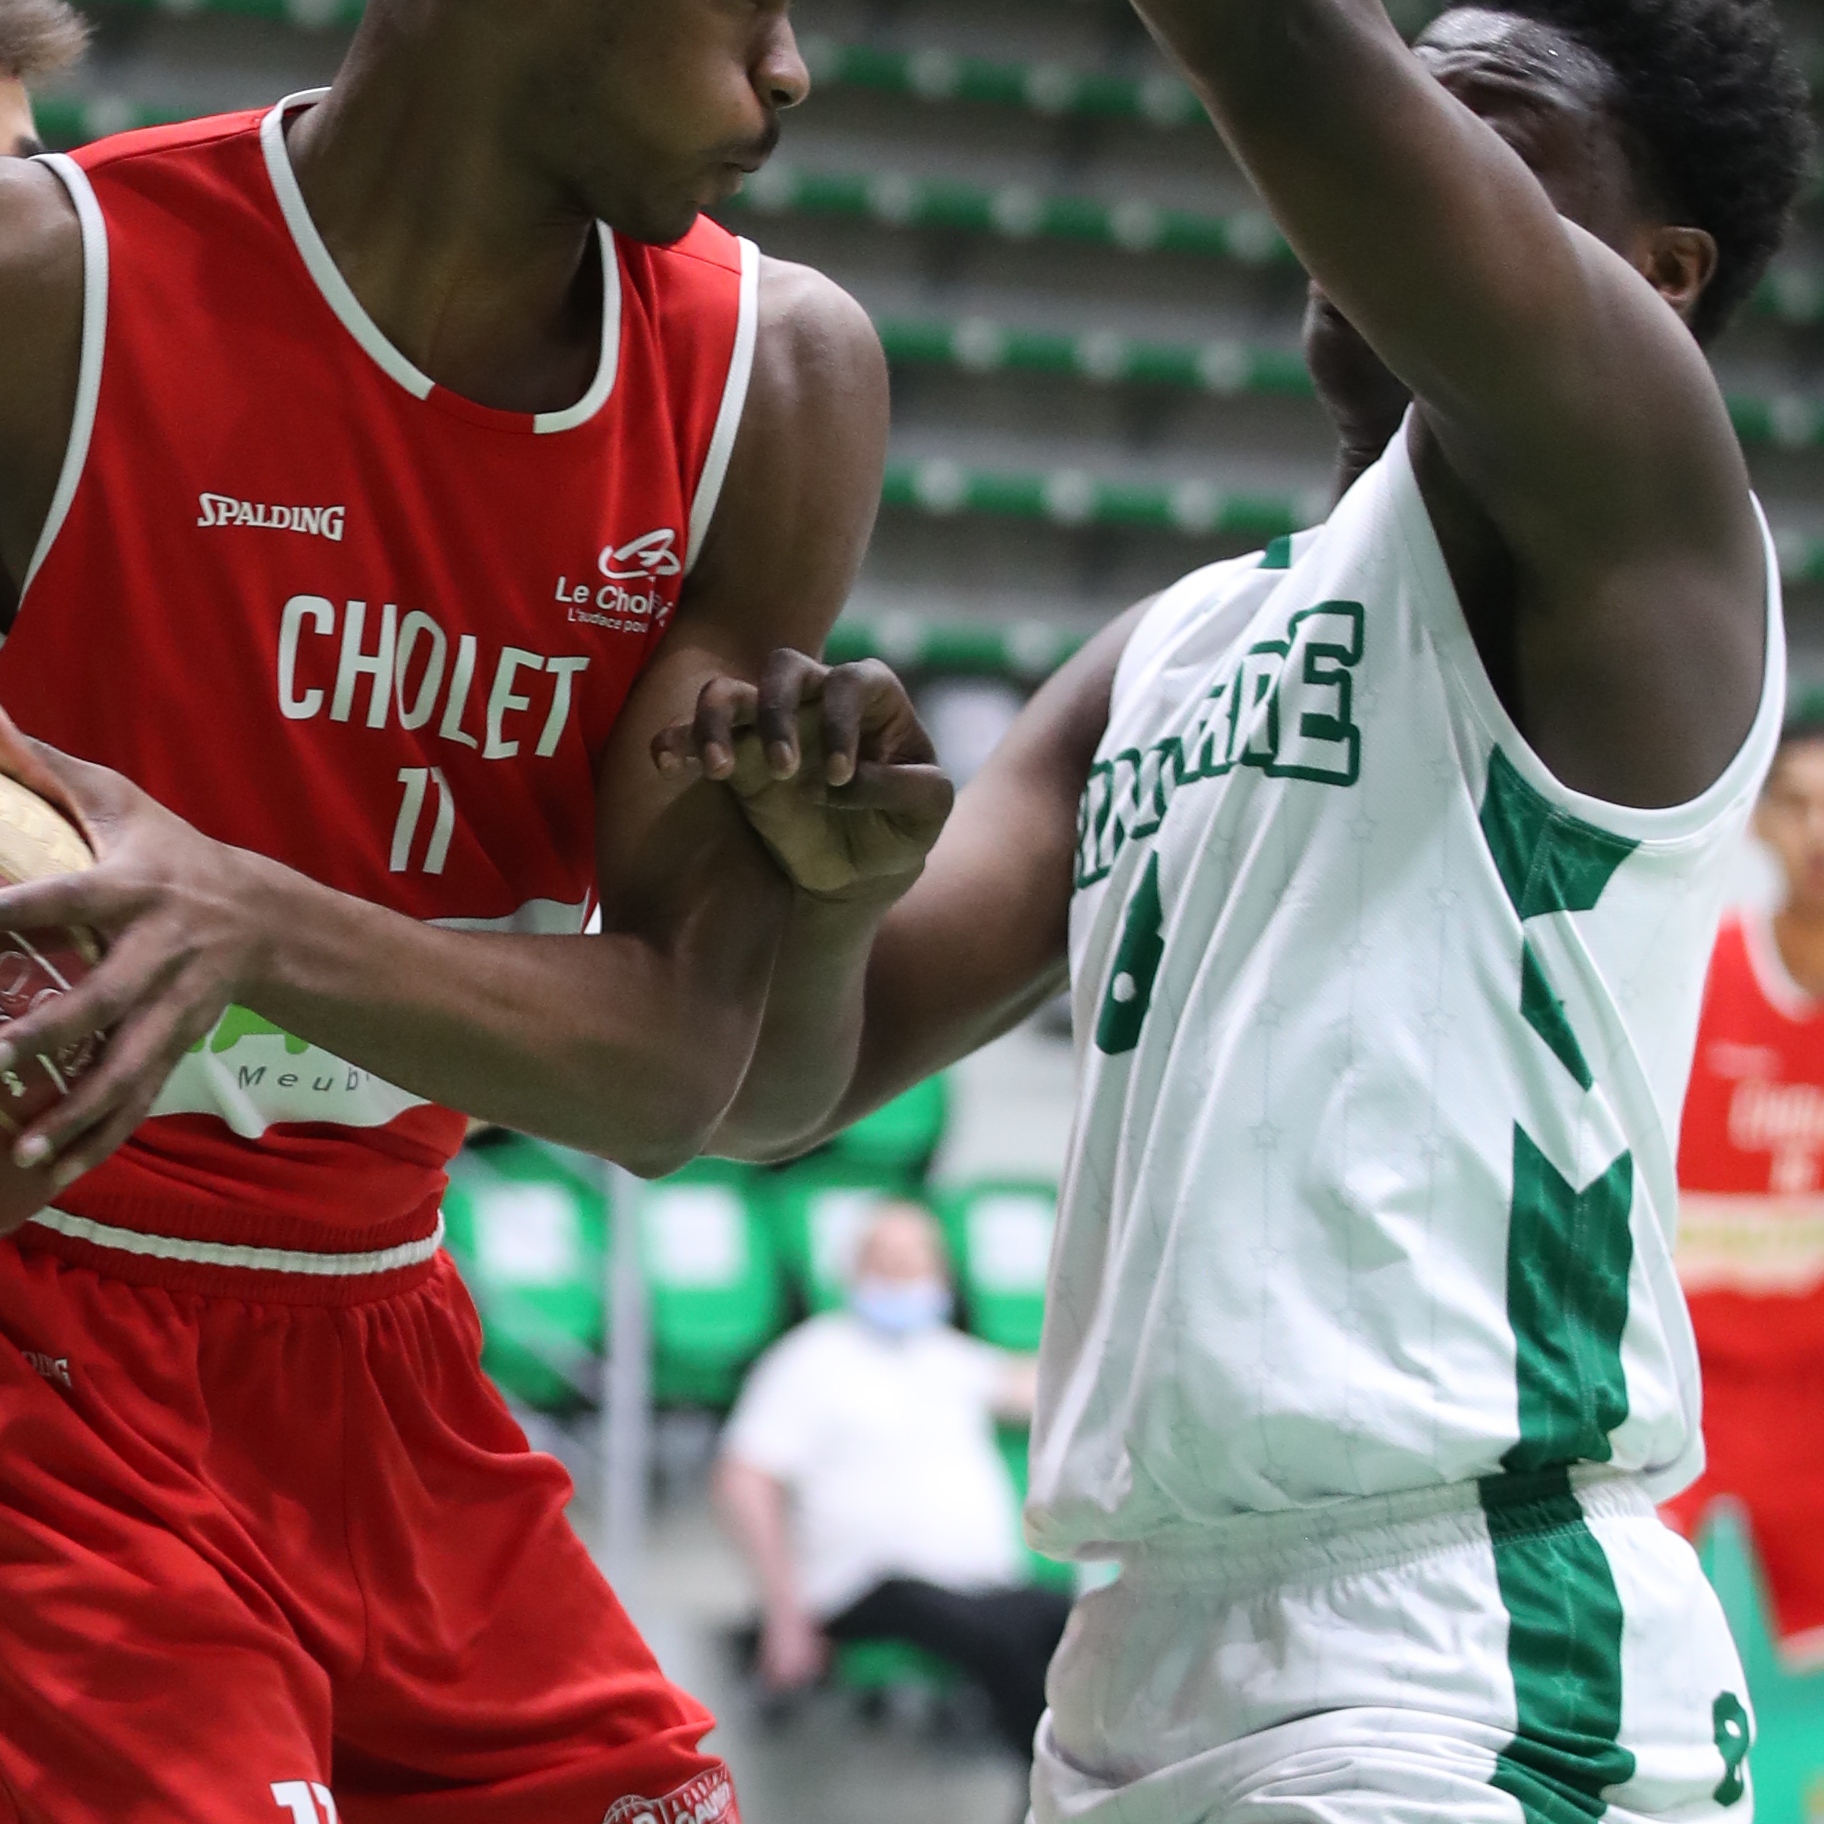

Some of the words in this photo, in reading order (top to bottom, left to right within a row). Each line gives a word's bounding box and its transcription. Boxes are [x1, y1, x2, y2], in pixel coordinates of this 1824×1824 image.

[197, 492, 346, 542] SPALDING
[554, 576, 591, 604] Le
[623, 618, 650, 634] pou
[277, 594, 591, 761] CHOLET
[389, 766, 456, 875] 11
